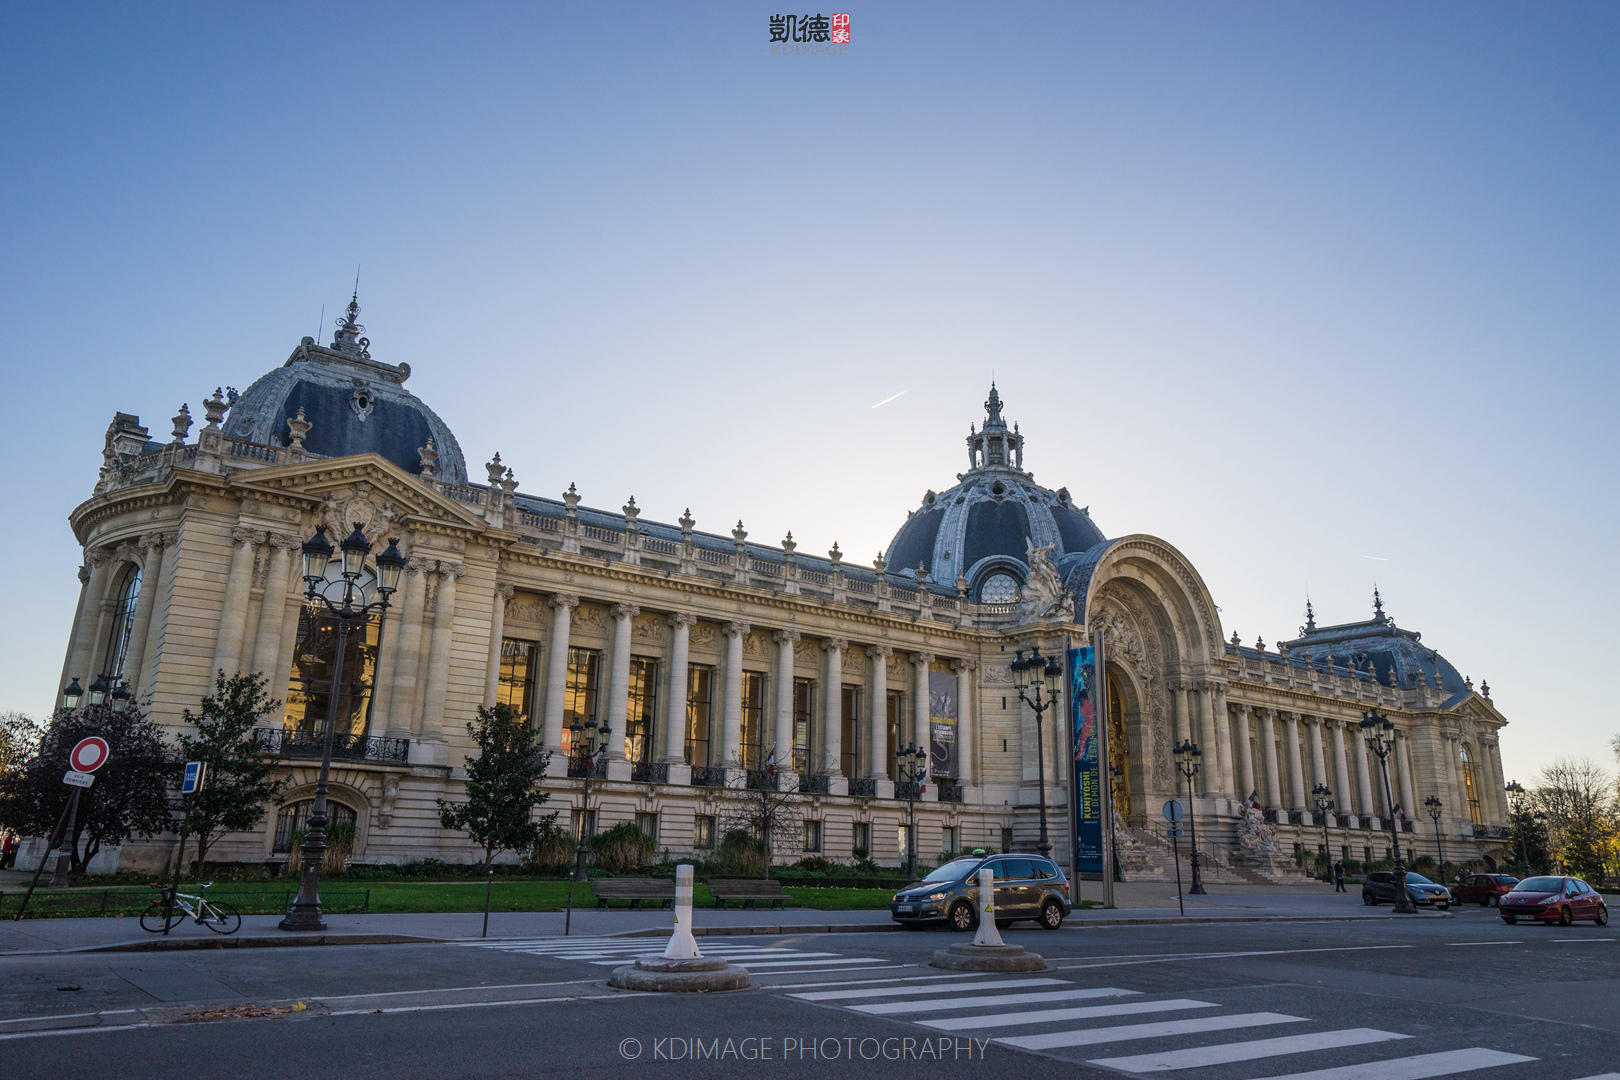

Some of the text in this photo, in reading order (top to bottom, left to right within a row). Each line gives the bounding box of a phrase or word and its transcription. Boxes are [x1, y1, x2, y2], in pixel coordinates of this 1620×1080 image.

[1090, 766, 1098, 777] DE
[1083, 771, 1092, 819] KUNIYOSHI
[1091, 808, 1100, 819] LE
